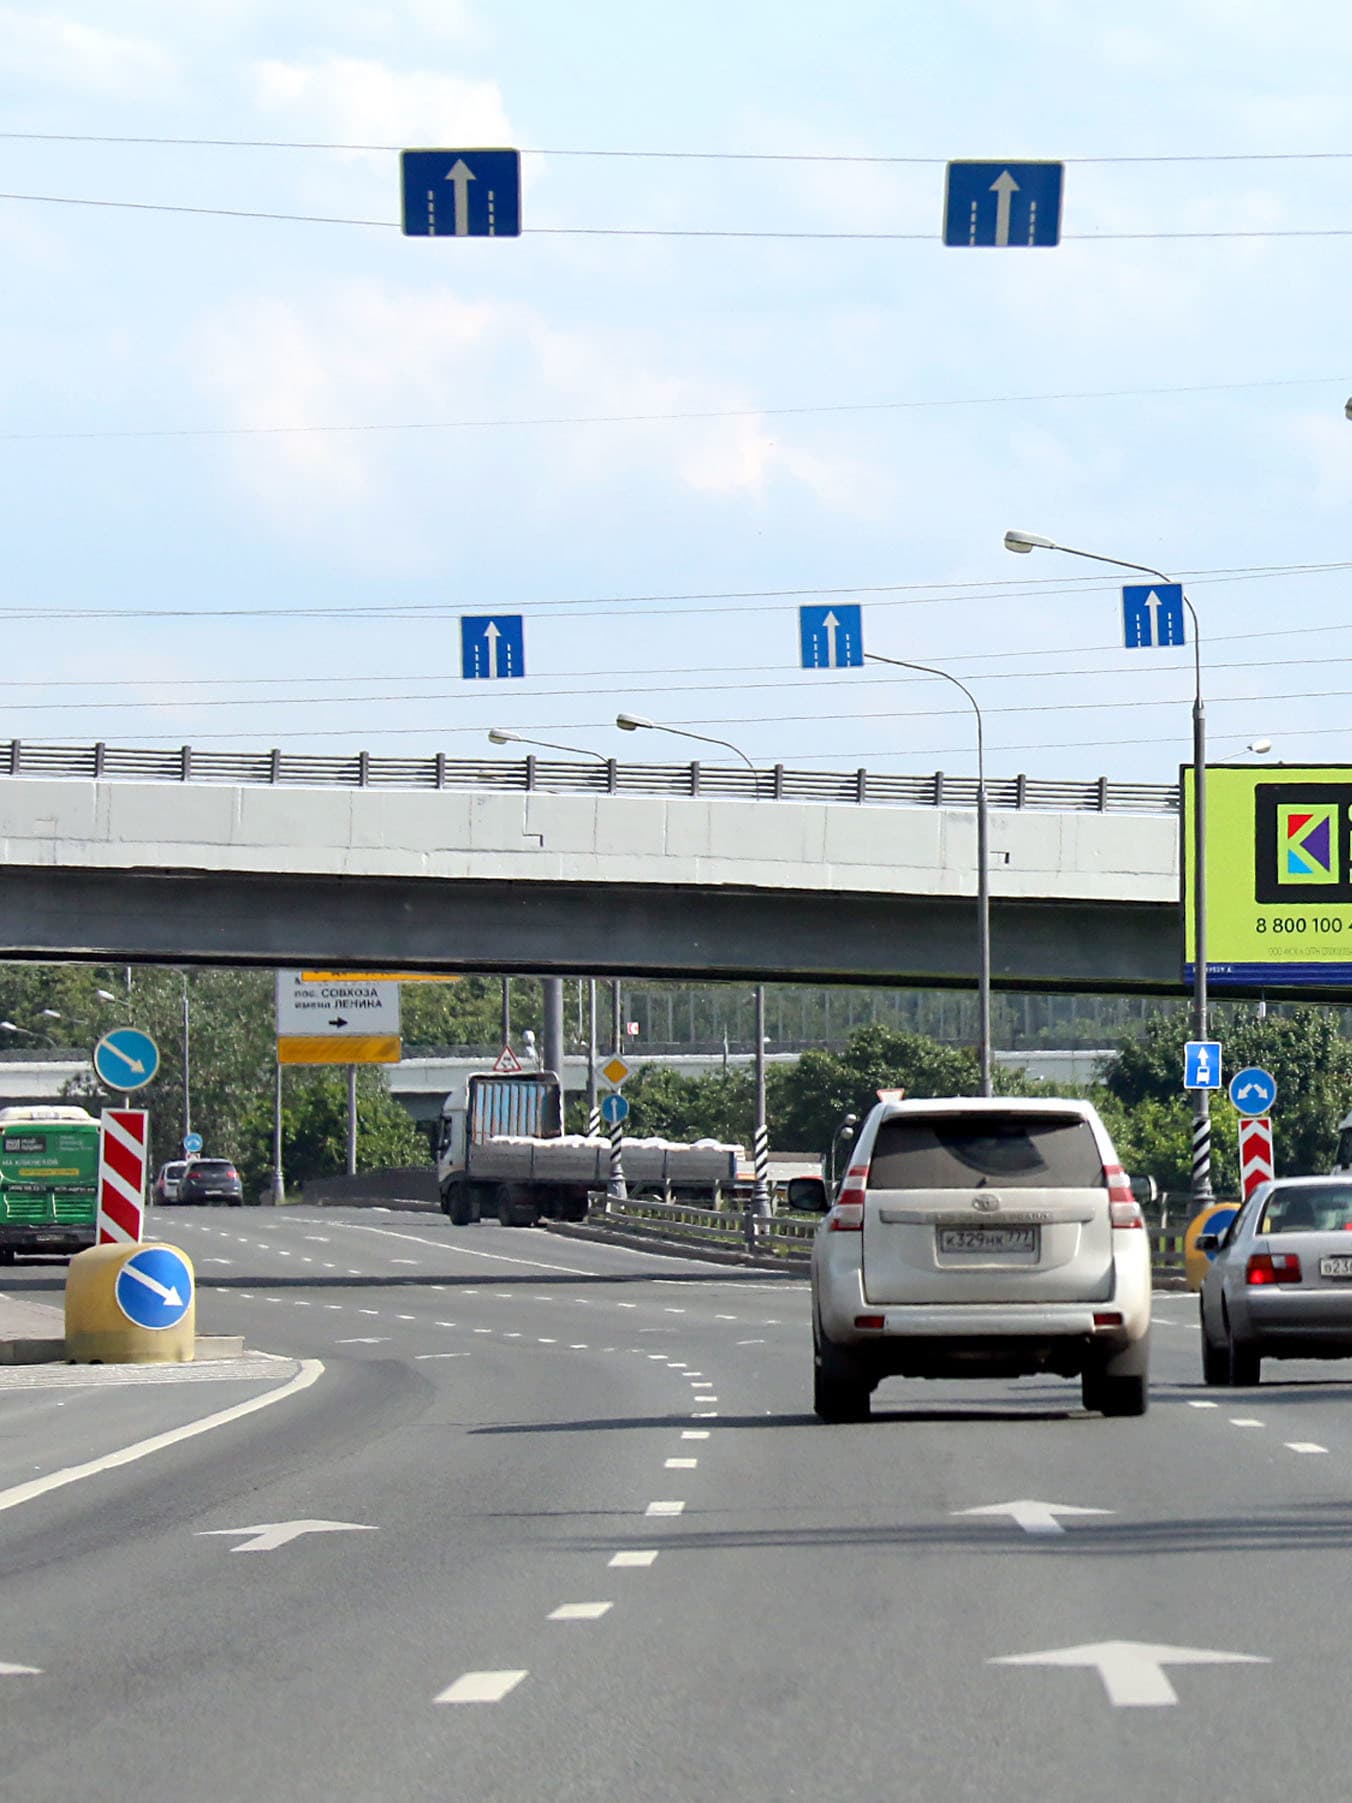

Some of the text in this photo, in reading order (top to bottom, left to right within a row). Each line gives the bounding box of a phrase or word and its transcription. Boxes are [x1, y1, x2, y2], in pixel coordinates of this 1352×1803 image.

[1256, 918, 1267, 933] 8
[1273, 918, 1306, 933] 800
[1313, 918, 1342, 933] 100
[321, 987, 378, 998] СОВХОЗА
[335, 999, 382, 1009] ЛЕНИНА
